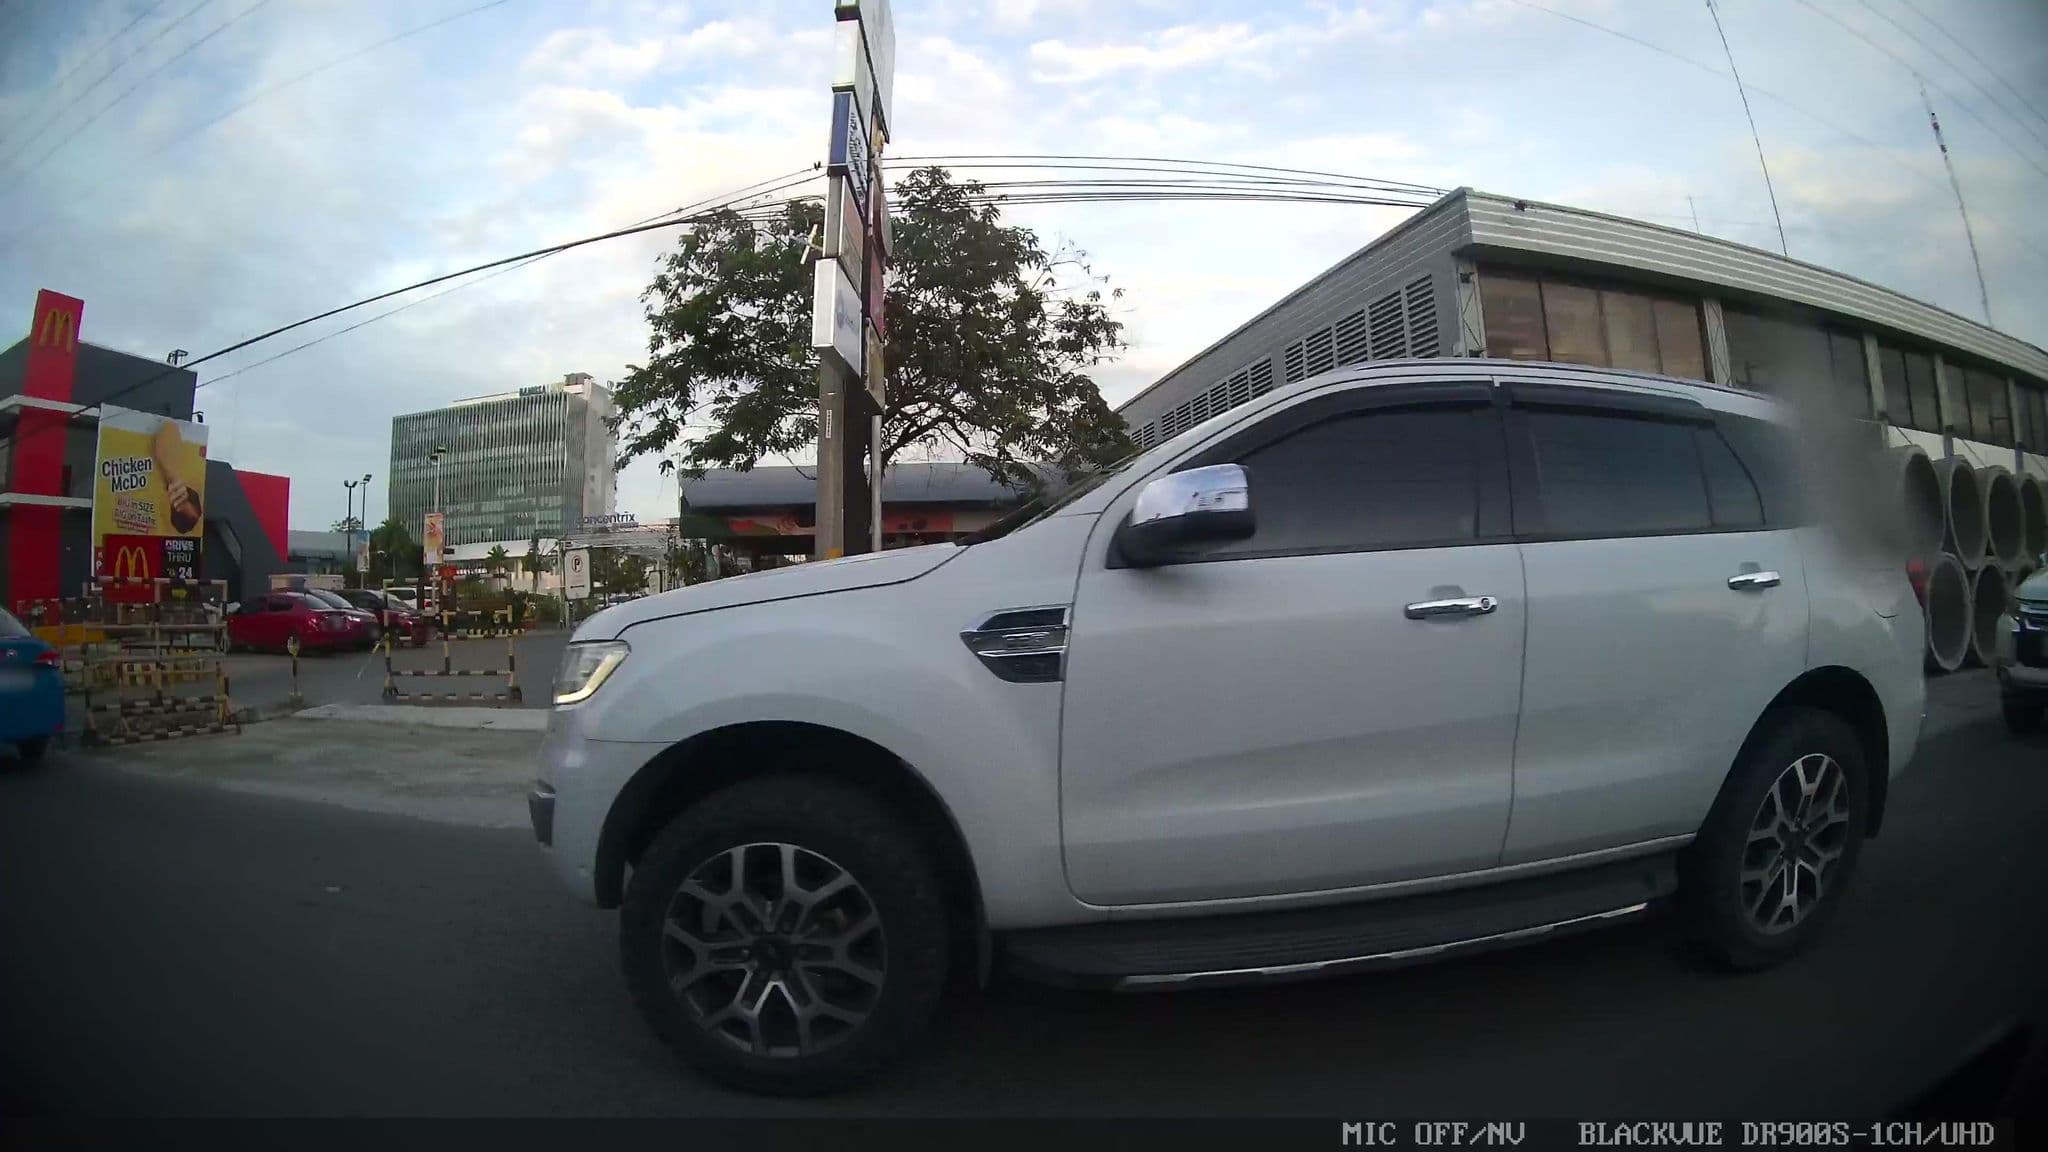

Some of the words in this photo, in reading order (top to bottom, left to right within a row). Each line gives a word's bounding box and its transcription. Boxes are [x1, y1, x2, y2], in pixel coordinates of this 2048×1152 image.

[101, 457, 152, 477] Chicken
[112, 474, 146, 492] McDo
[577, 511, 636, 525] oncentrix
[165, 539, 194, 551] DRIVE
[167, 551, 192, 562] THRU
